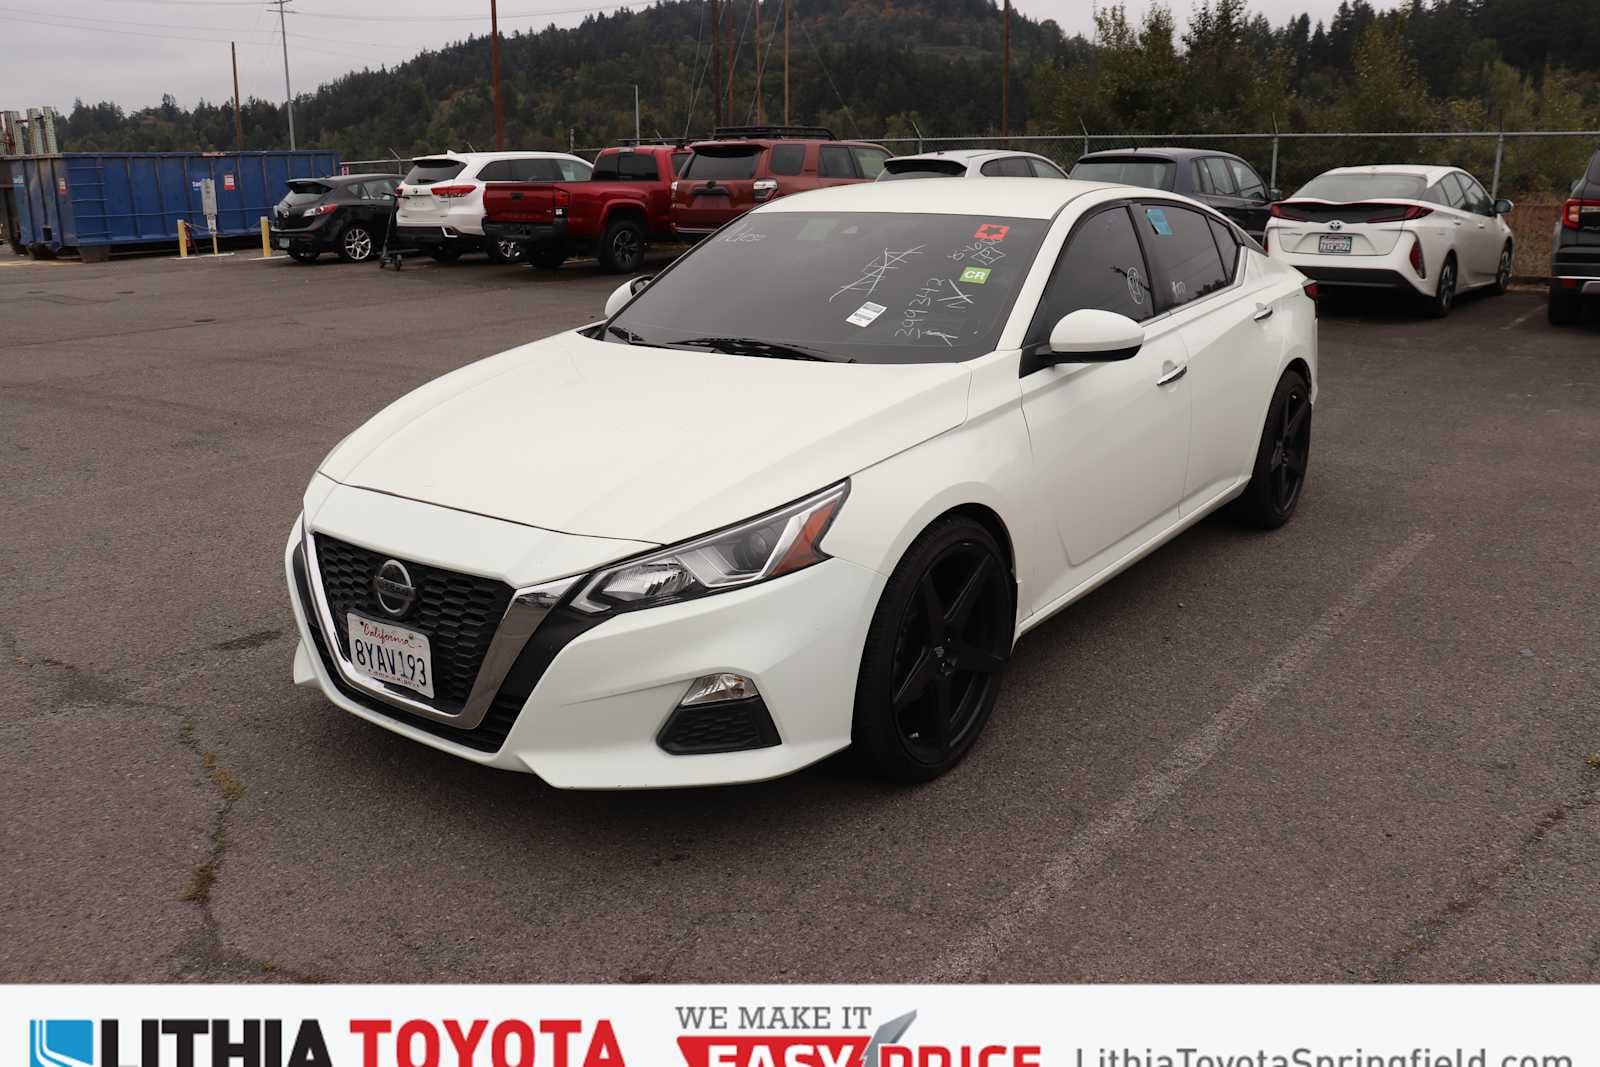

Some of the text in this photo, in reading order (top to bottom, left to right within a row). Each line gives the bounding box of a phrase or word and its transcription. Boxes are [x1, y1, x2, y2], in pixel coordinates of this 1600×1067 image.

[963, 270, 986, 280] CR
[363, 623, 410, 645] California
[355, 639, 427, 686] 8YAV193
